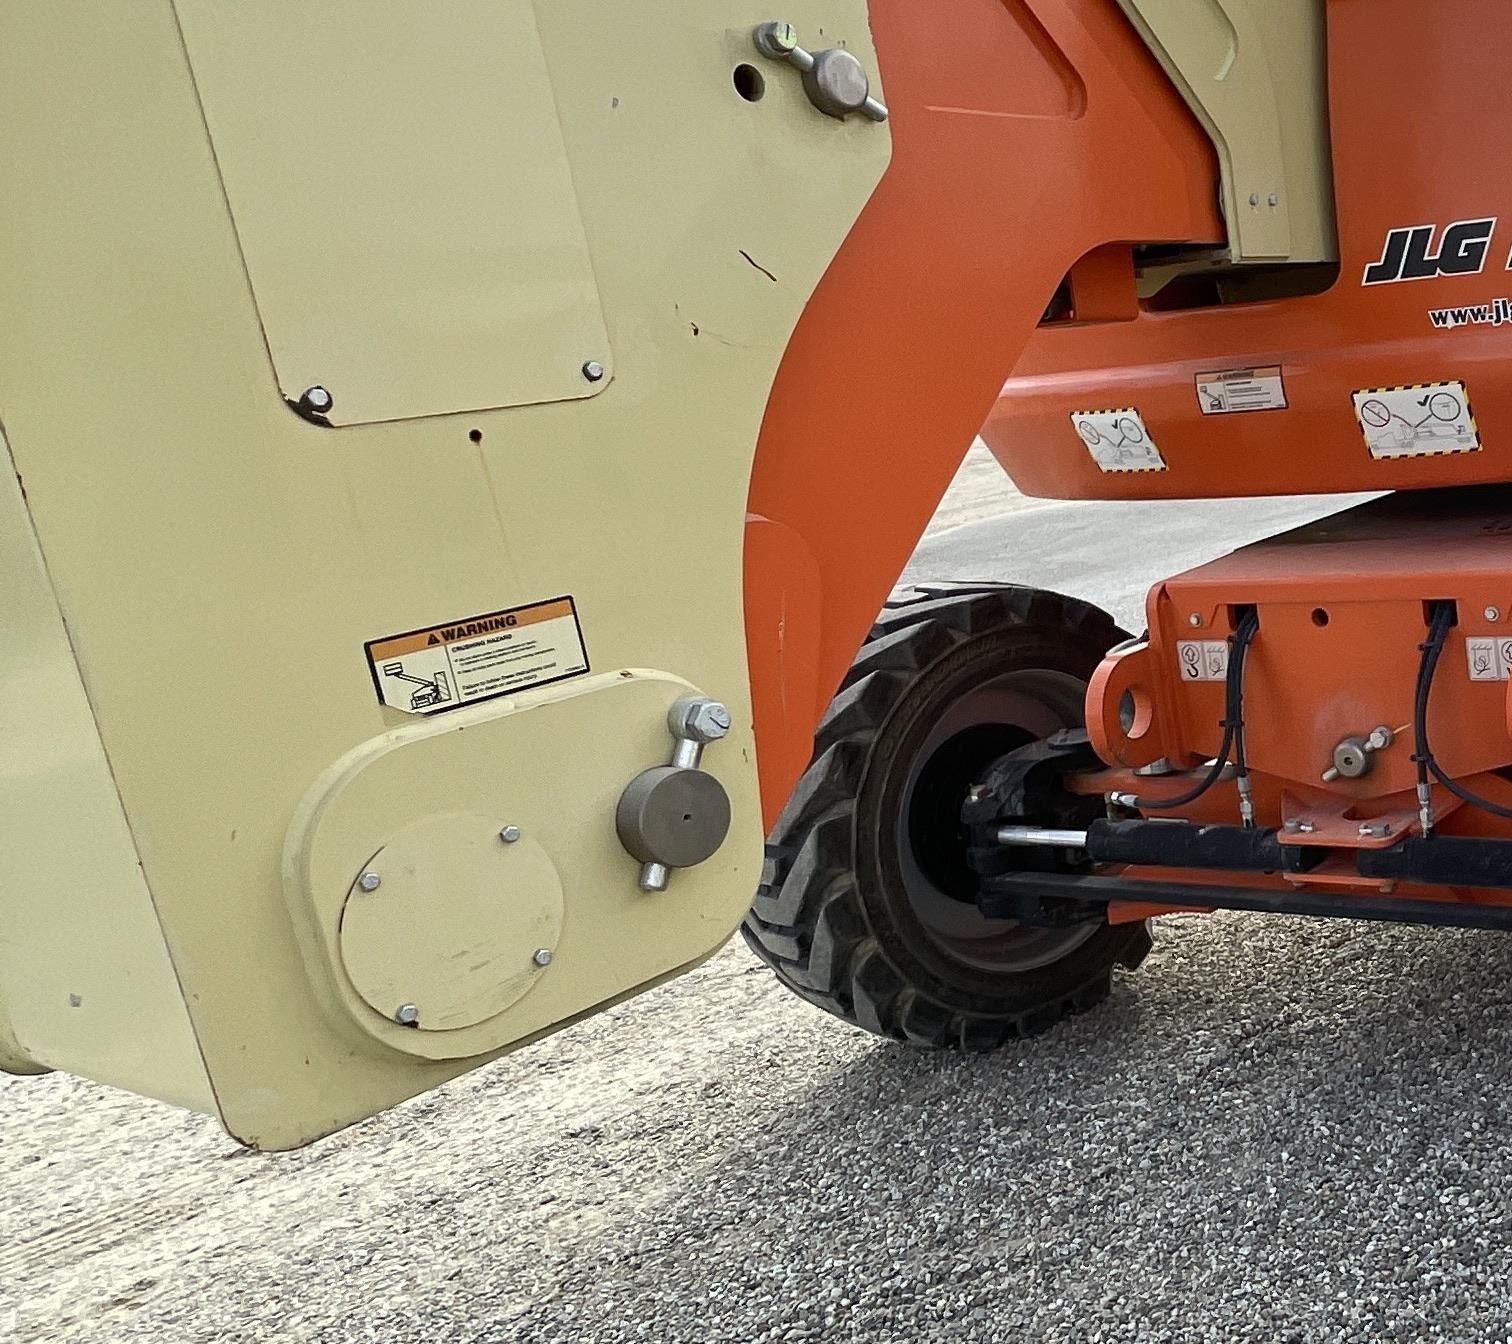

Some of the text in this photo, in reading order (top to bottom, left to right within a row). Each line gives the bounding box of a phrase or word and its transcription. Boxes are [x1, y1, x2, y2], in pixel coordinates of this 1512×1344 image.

[1361, 217, 1497, 286] JLG
[441, 615, 517, 641] WARNING
[486, 634, 513, 644] HAZARD
